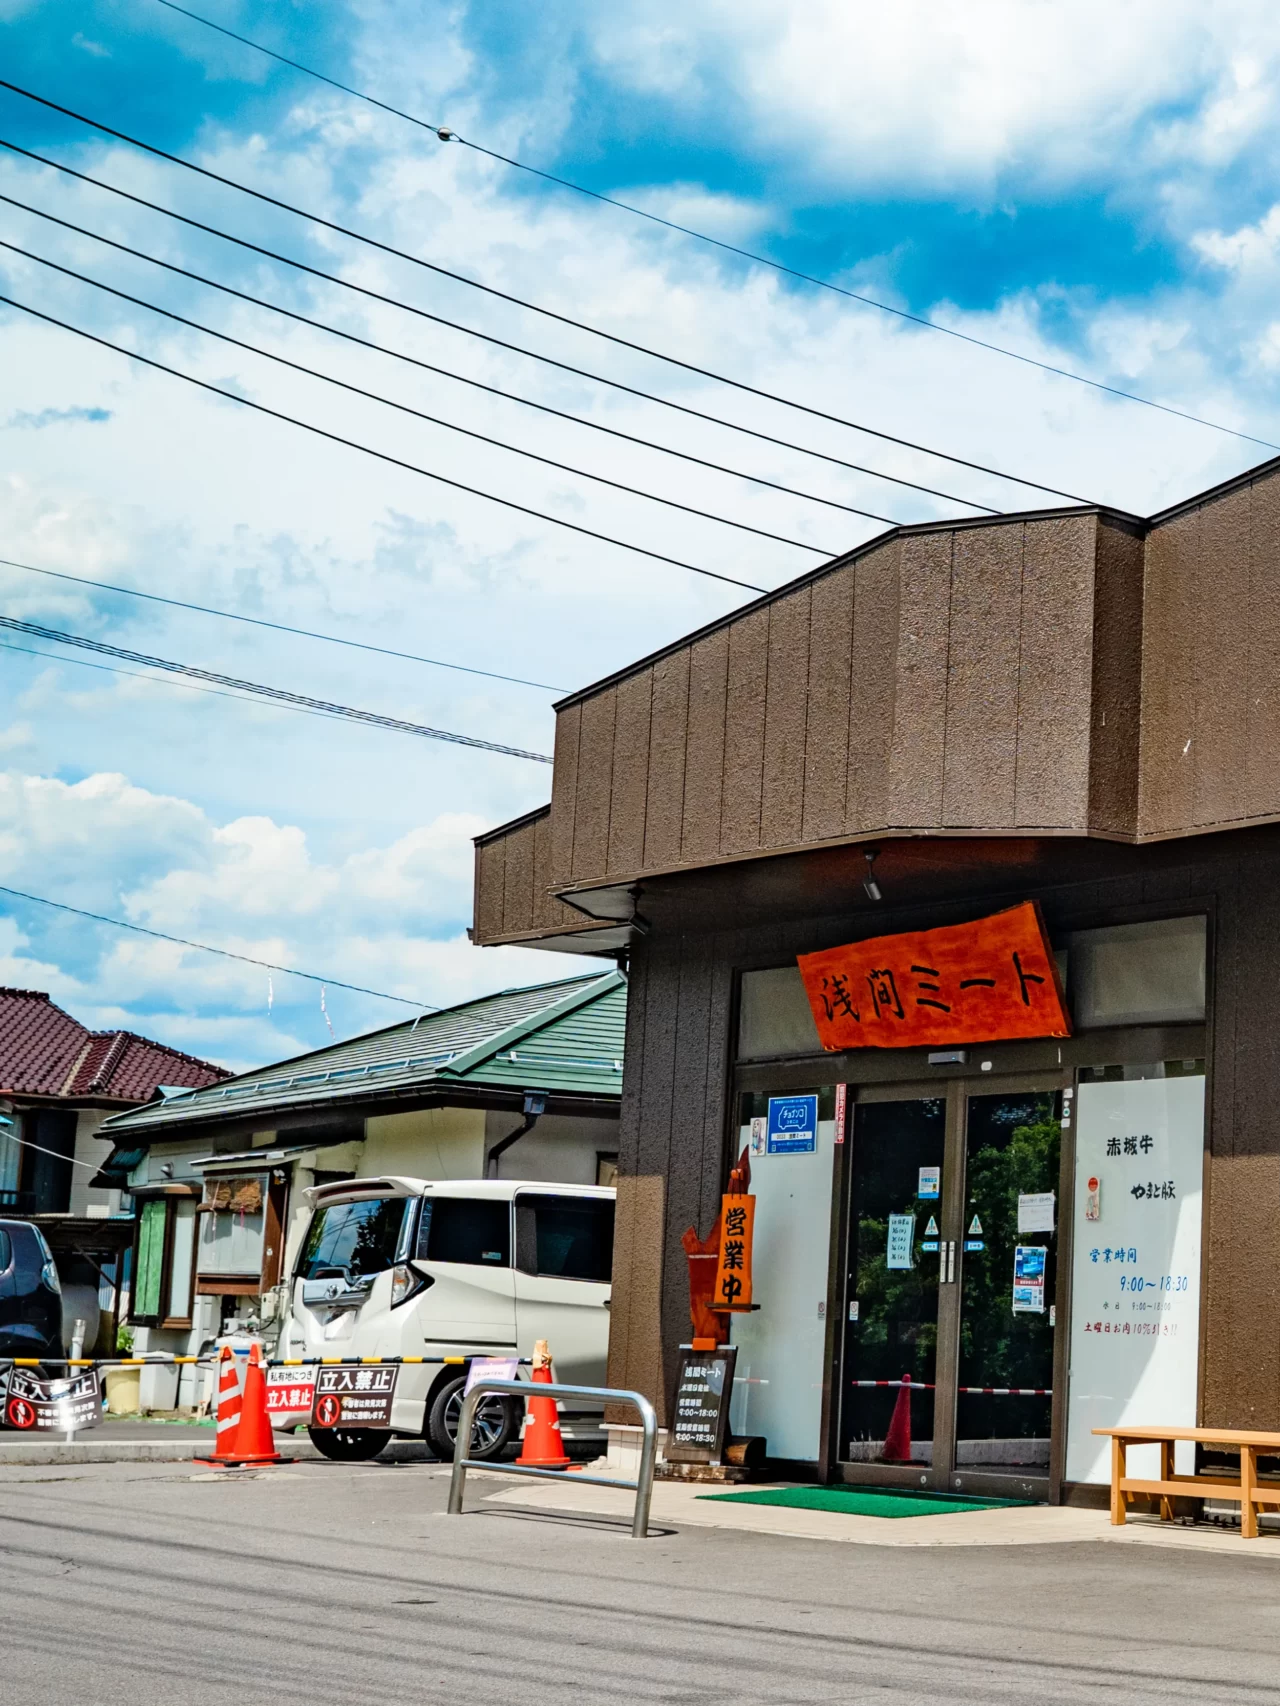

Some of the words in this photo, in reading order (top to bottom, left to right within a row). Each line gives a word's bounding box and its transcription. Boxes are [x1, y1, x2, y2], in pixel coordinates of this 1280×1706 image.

[820, 951, 1046, 1023] 浅間ミート
[1106, 1134, 1154, 1156] 赤城牛
[1130, 1180, 1176, 1200] やまと豚
[722, 1207, 747, 1304] 営業中
[1089, 1248, 1138, 1264] 営業時間
[270, 1370, 313, 1382] 私有地につき
[320, 1370, 391, 1391] 立入禁止
[267, 1388, 311, 1408] 立入禁止
